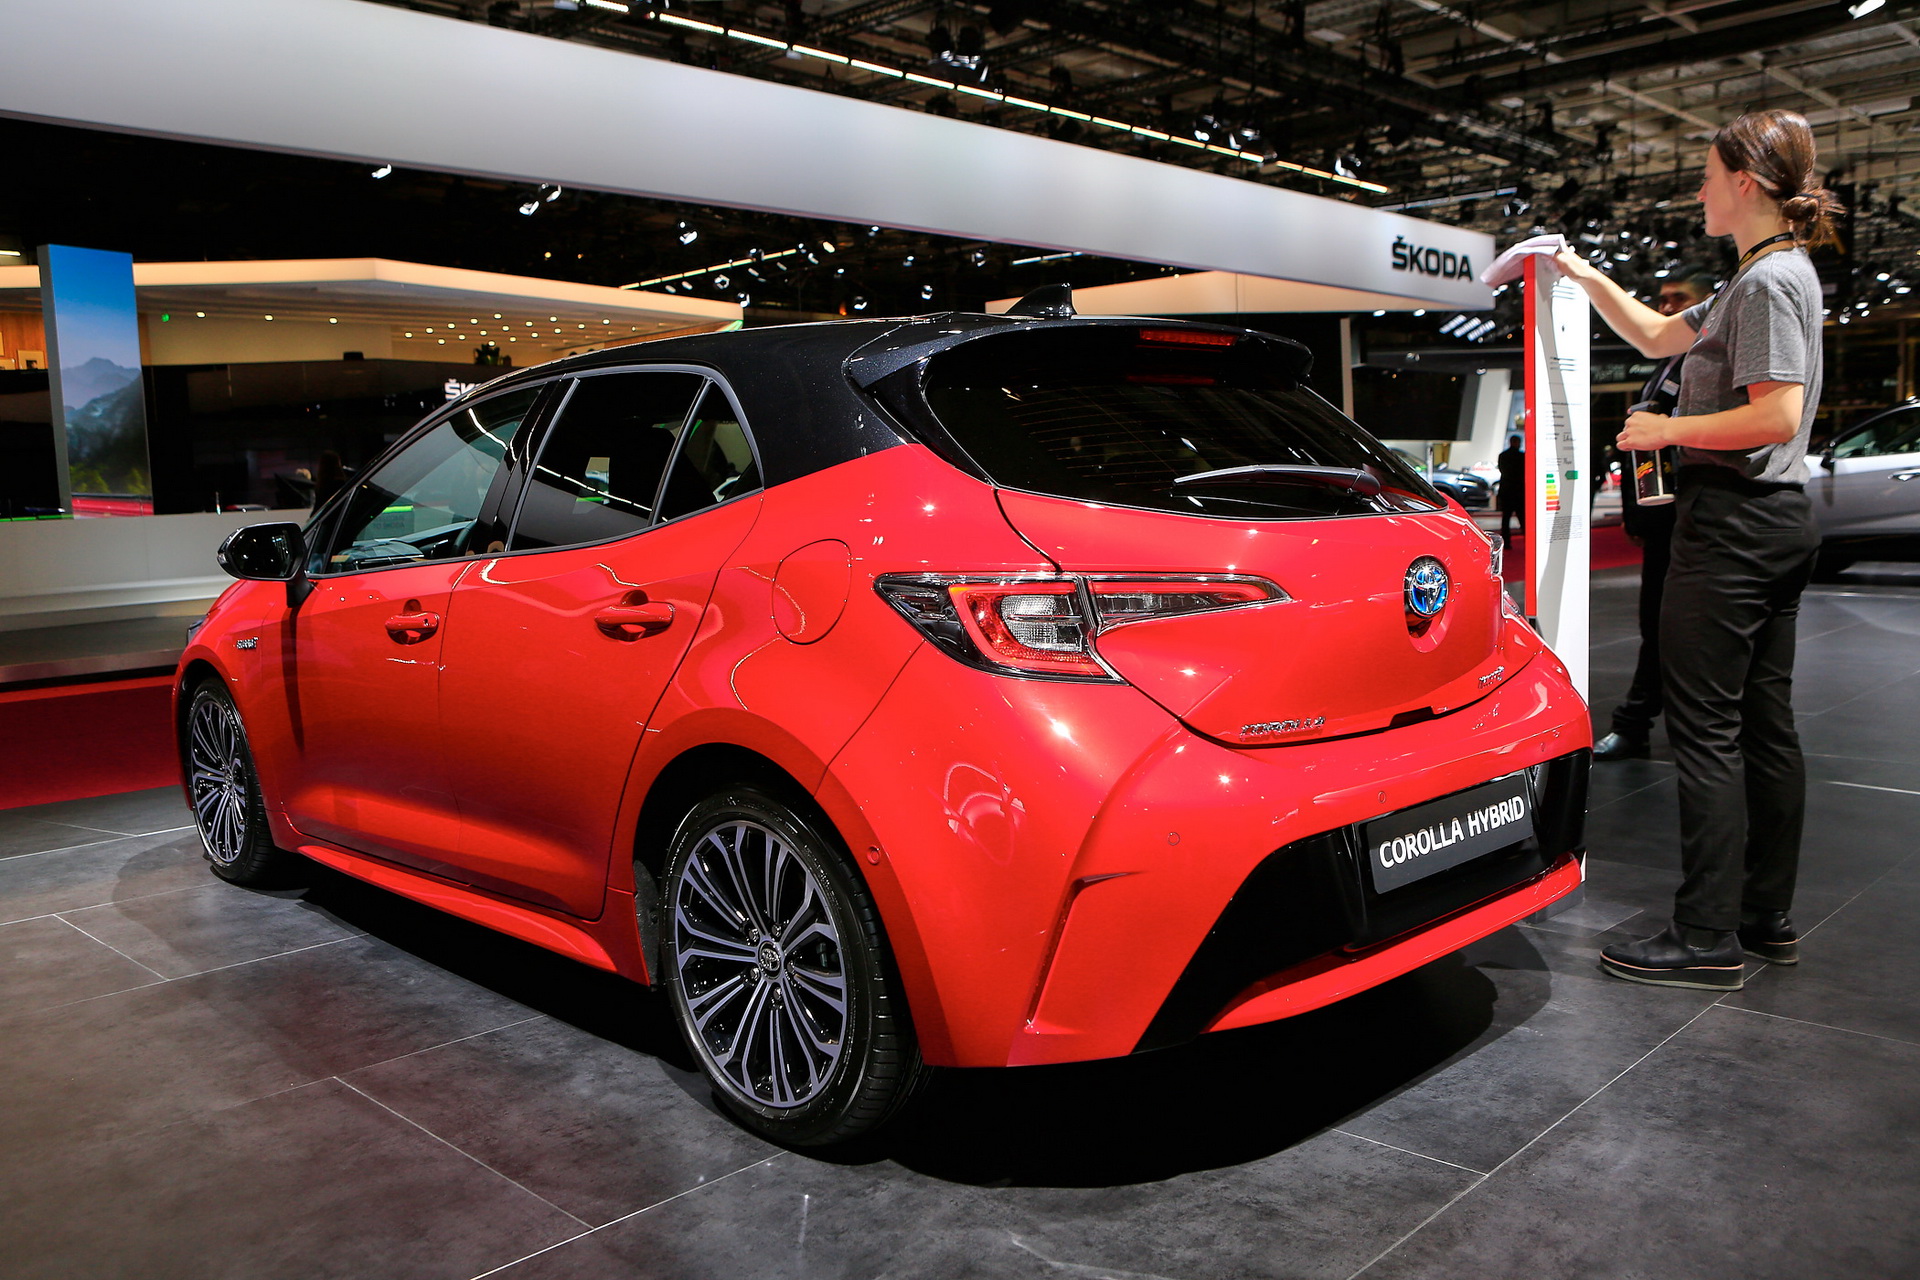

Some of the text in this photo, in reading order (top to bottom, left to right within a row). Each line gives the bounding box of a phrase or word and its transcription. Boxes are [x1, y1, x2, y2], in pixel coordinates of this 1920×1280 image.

[1392, 235, 1473, 282] ŠKODA
[1379, 795, 1525, 869] COROLLA HYBRID
